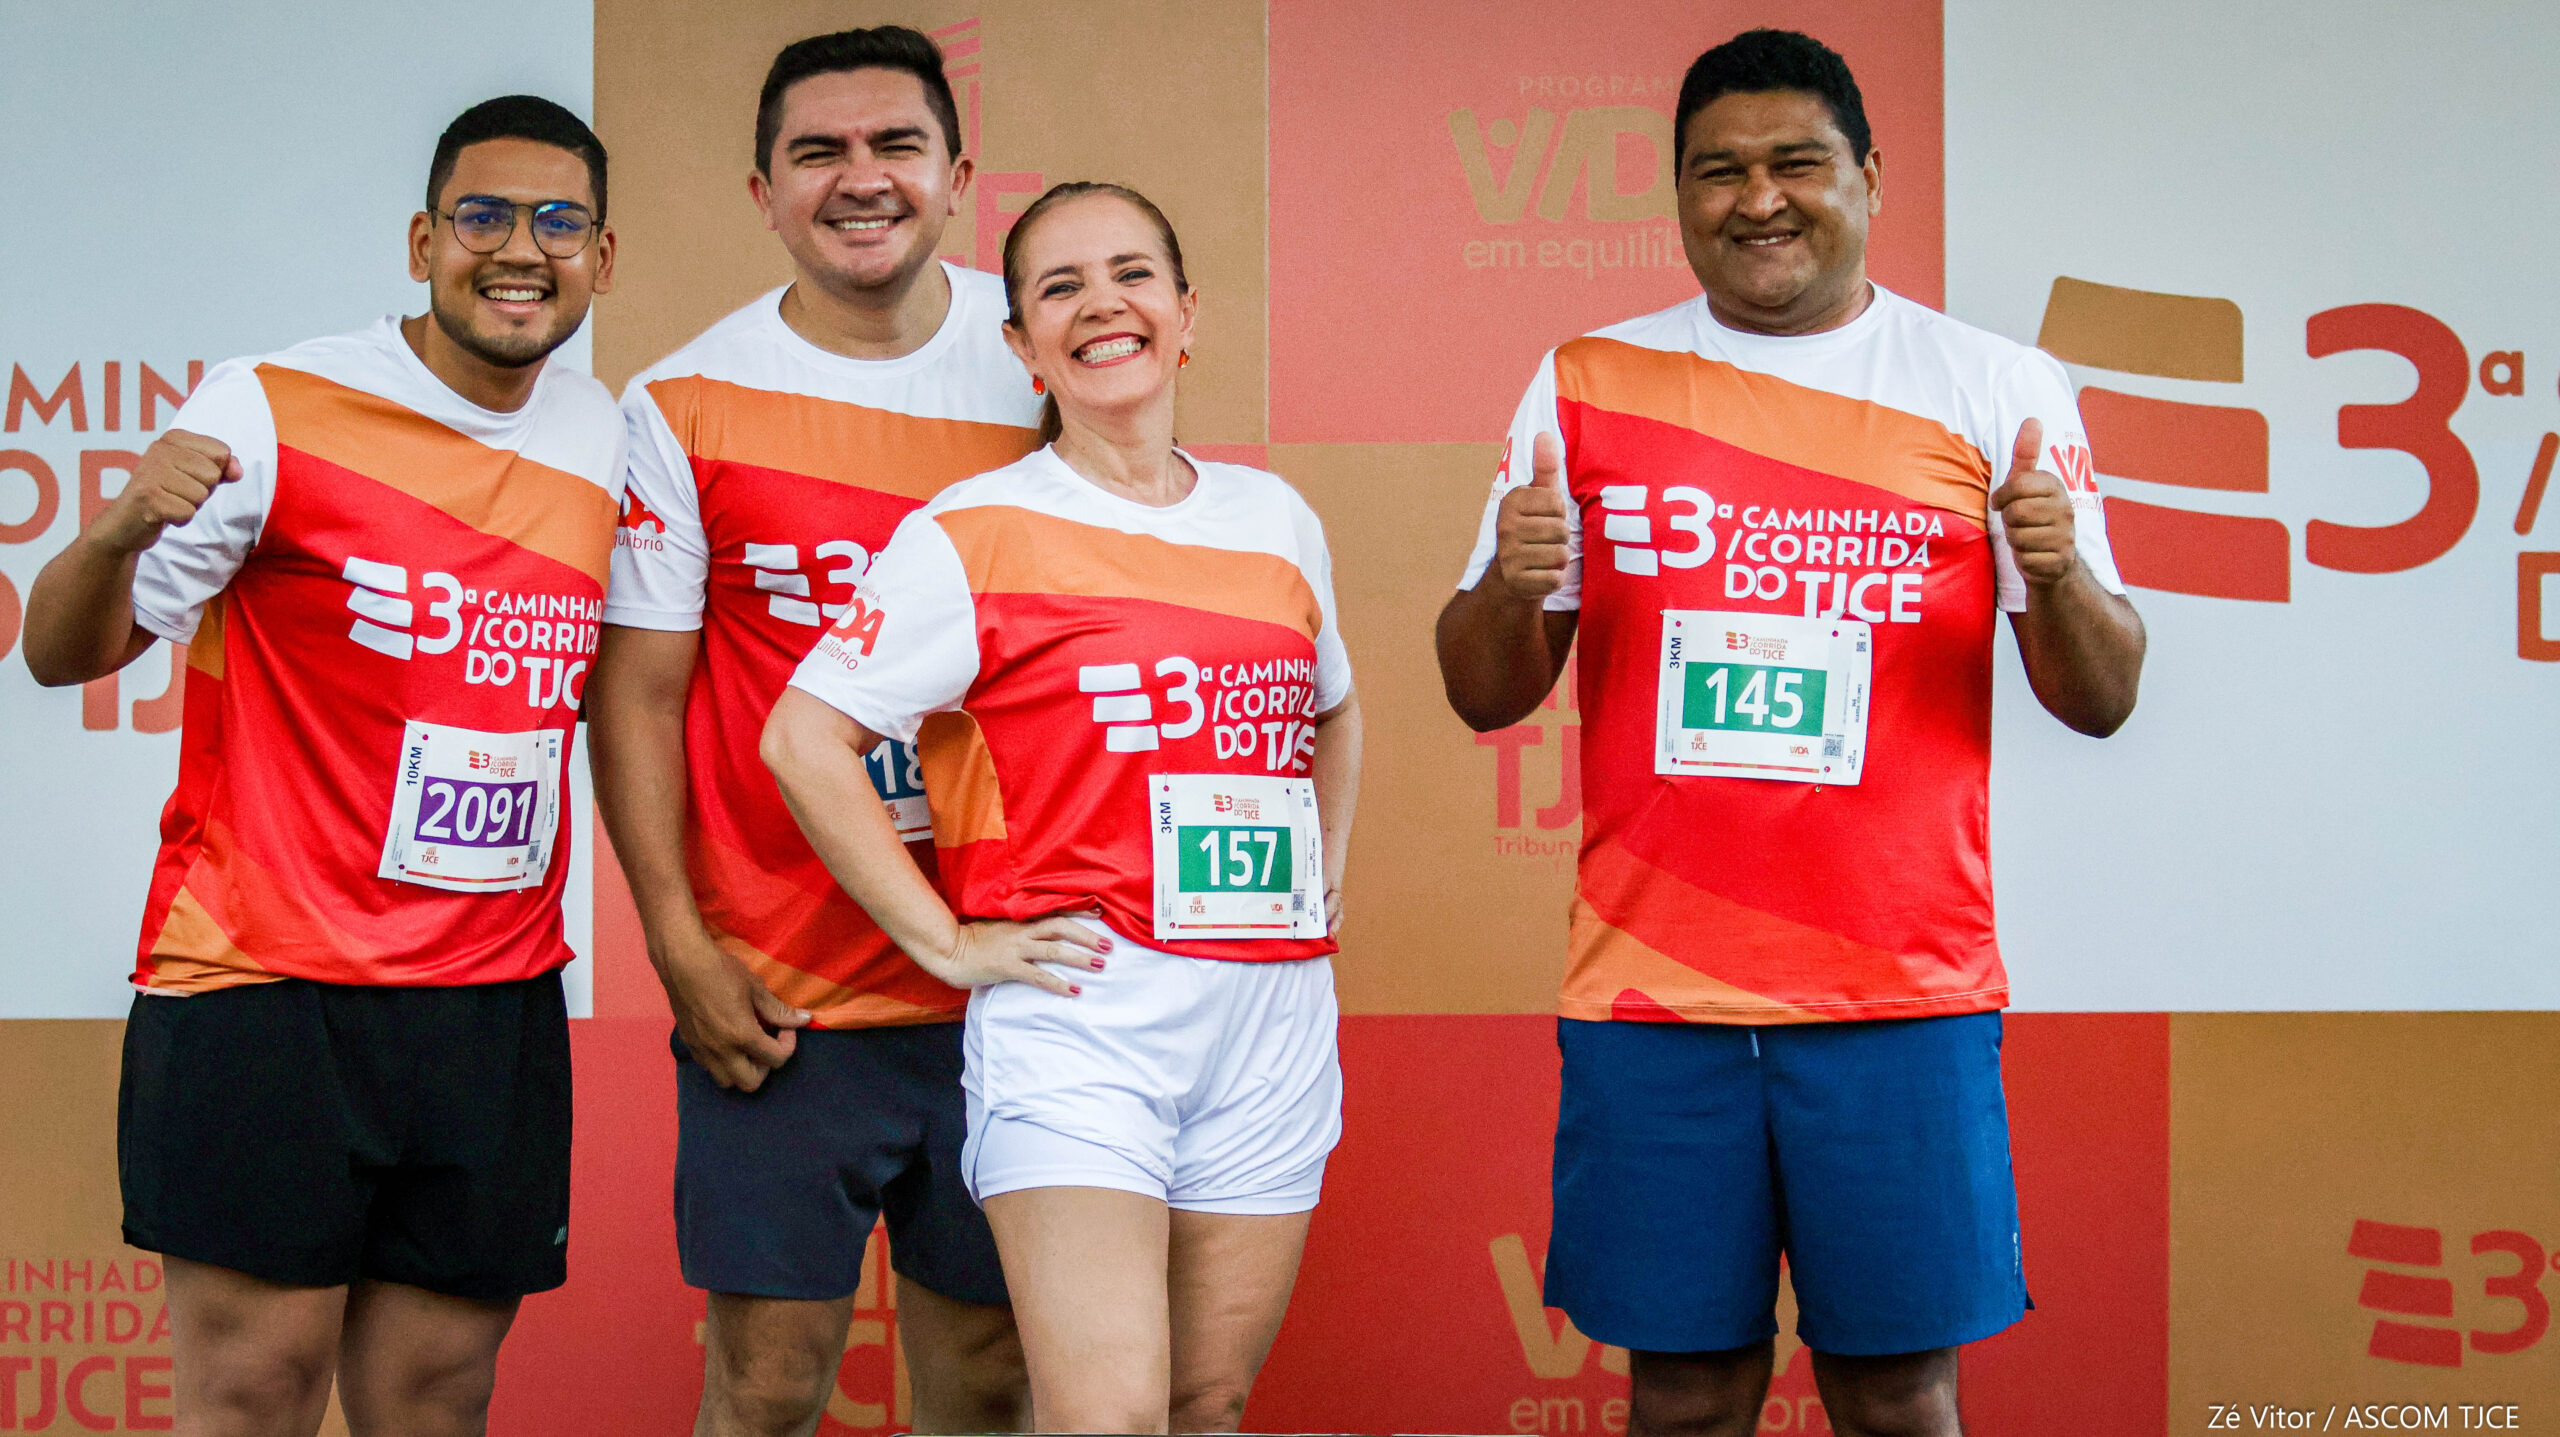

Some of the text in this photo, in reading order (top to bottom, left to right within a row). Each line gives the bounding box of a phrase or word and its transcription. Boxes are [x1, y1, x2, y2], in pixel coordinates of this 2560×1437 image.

[1463, 239, 1526, 268] em
[1661, 486, 1945, 569] 3ª CAMINHADA
[1725, 529, 1931, 567] /CORRIDA
[1725, 563, 1923, 624] DO TJCE
[465, 649, 516, 686] DO
[1669, 637, 1682, 669] 3KM
[1762, 649, 1786, 661] TJCE
[1705, 667, 1804, 728] 145
[1214, 722, 1257, 760] DO
[406, 746, 423, 787] 10KM
[419, 781, 533, 843] 2091
[1160, 801, 1173, 834] 3KM
[1243, 810, 1261, 820] TJCE
[420, 854, 440, 865] TJCE
[1199, 830, 1278, 887] 157
[1494, 836, 1581, 857] Tribun
[0, 1259, 163, 1294] INHAD
[0, 1355, 174, 1433] TJCE
